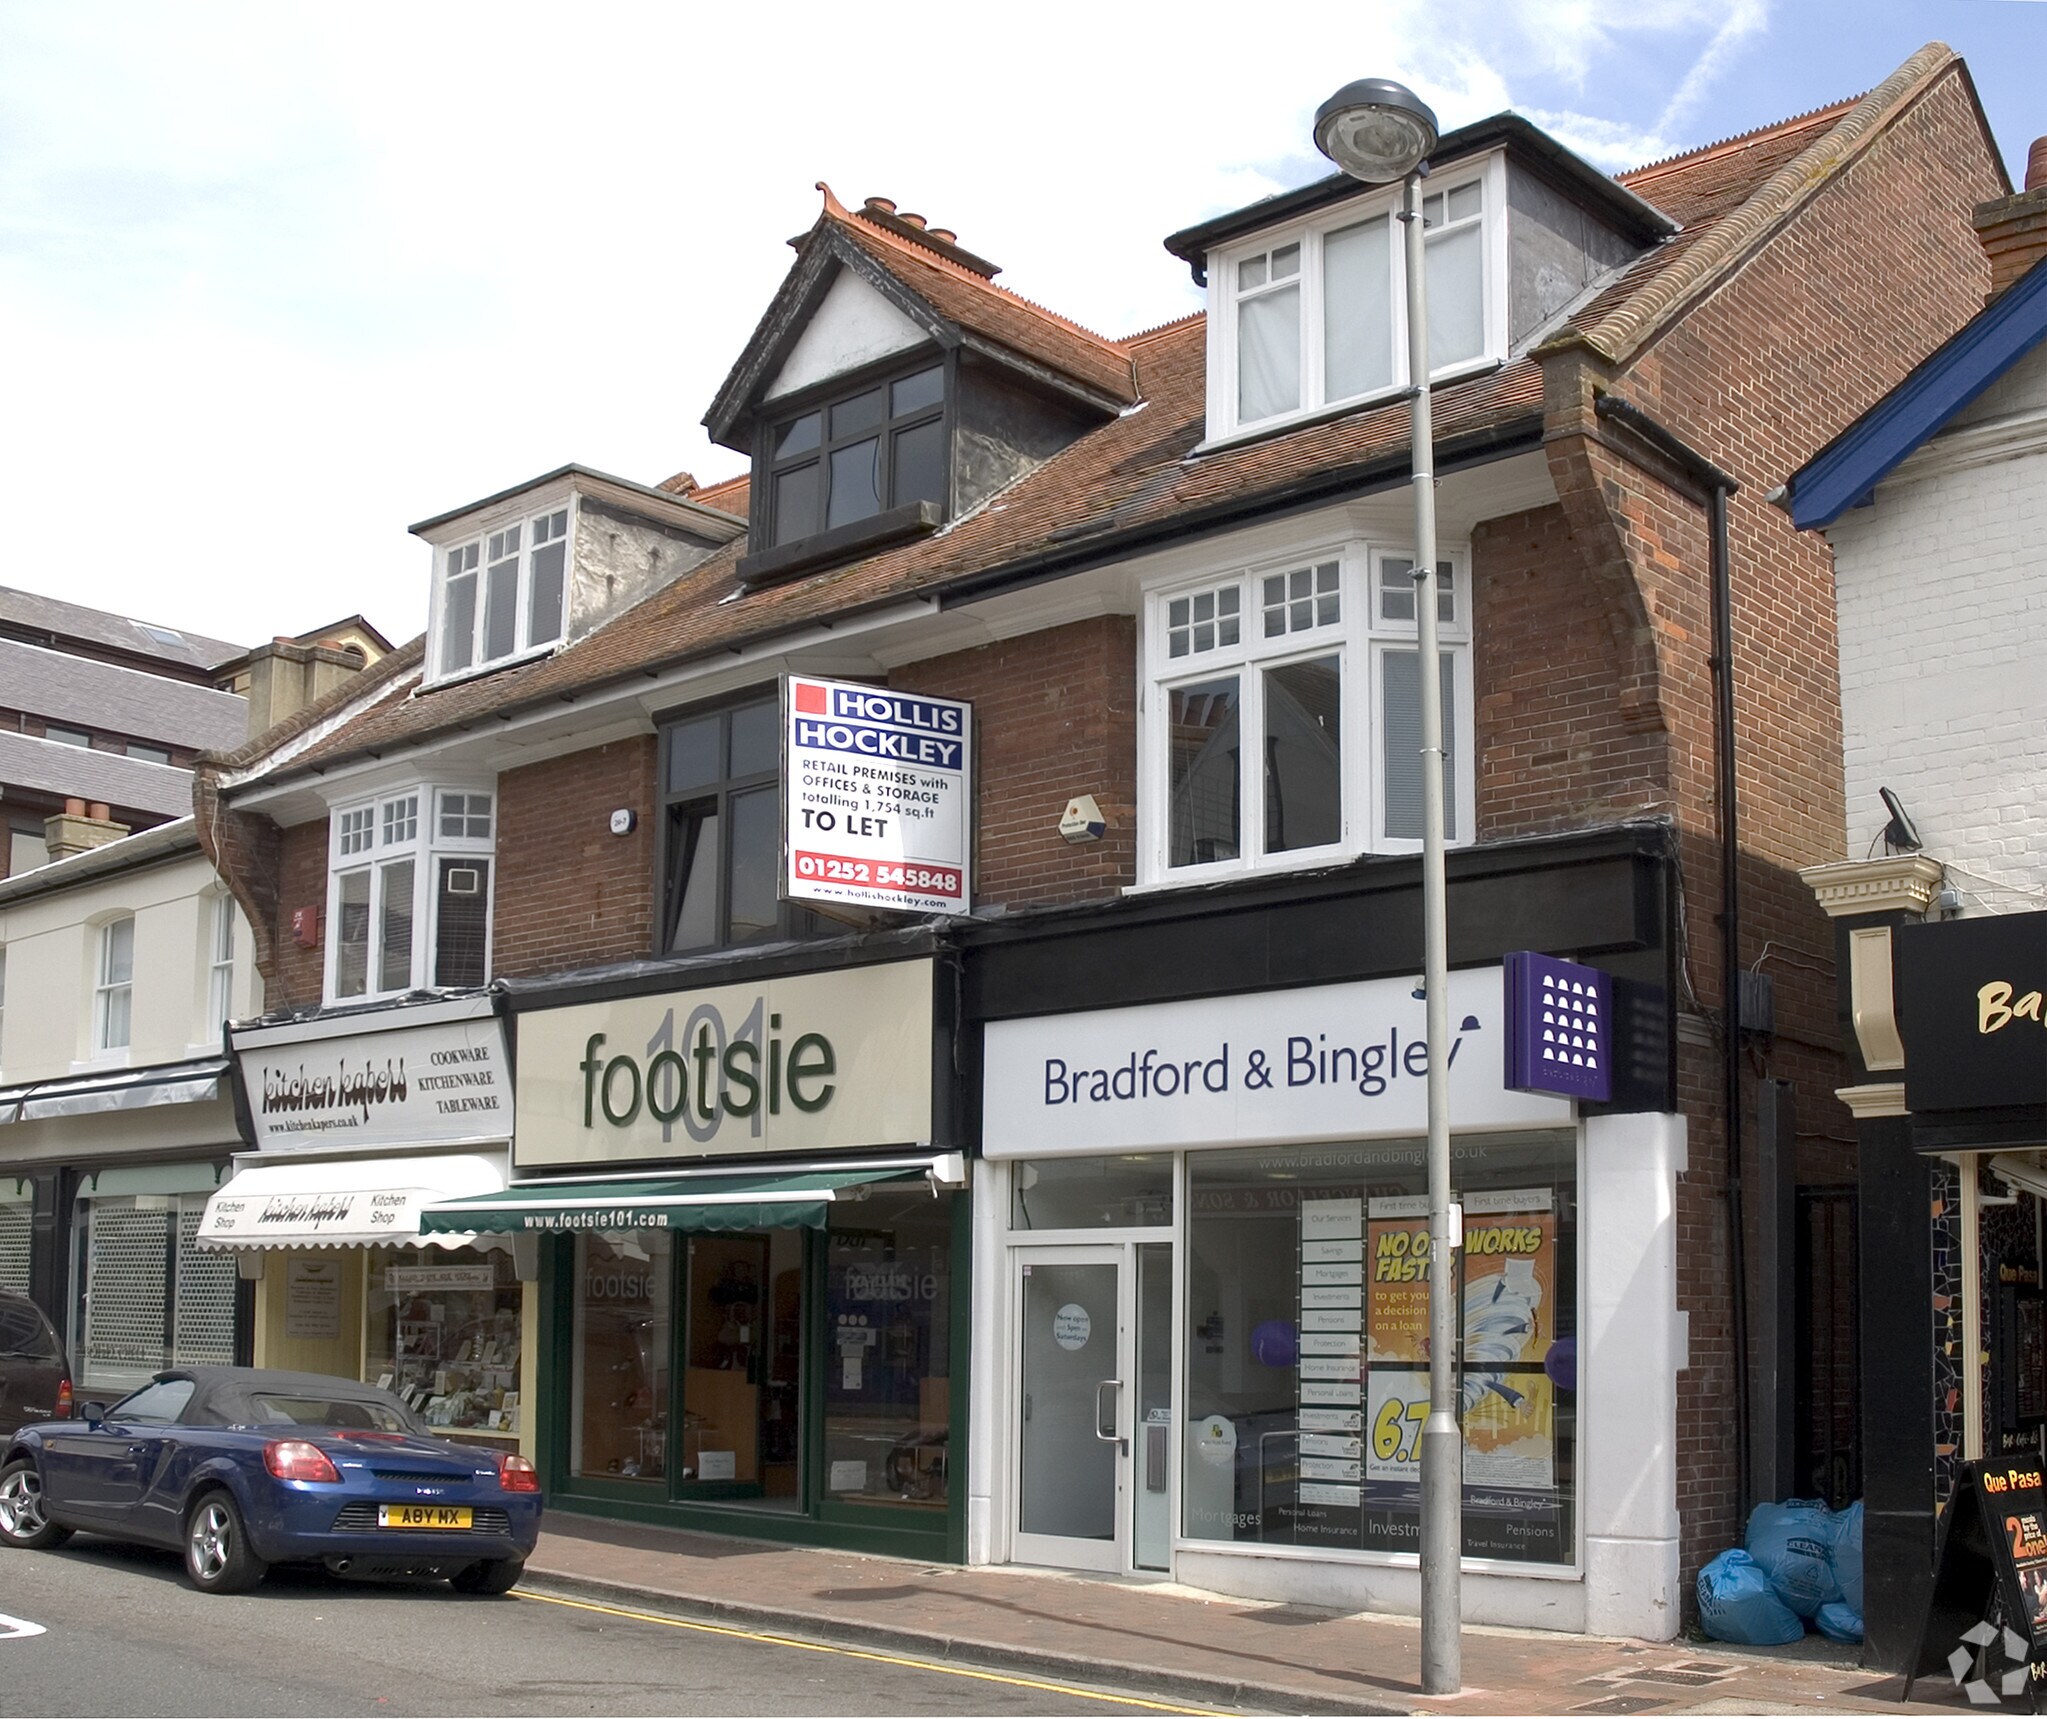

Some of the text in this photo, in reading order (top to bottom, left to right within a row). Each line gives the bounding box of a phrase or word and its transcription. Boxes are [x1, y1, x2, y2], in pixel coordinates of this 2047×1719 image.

[839, 692, 958, 732] HOLLIS
[799, 722, 957, 765] HOCKLEY
[802, 759, 949, 791] RETAIL PREMISES with
[802, 775, 940, 805] OFFICES & STORAGE
[802, 792, 935, 820] totalling 1,754 sq.ft
[801, 808, 888, 838] TO LET
[798, 856, 958, 892] 01252 545848
[813, 887, 947, 908] www.hollishockley.com
[1977, 980, 2047, 1034] Ba
[430, 1047, 490, 1066] COOKWARE
[579, 1012, 836, 1128] footsie
[646, 996, 763, 1144] 101
[1044, 1042, 1229, 1106] Bradford
[1244, 1049, 1274, 1091] &
[417, 1071, 495, 1092] KITCHENWARE
[435, 1096, 500, 1114] TABLEWARE
[268, 1115, 359, 1133] www.kitchenkapers.co.uk
[1259, 1145, 1487, 1169] www.bradfordandbinglco.uk
[215, 1200, 245, 1213] Kitchen
[370, 1194, 407, 1207] Kitchen
[214, 1216, 236, 1229] Shop
[370, 1211, 396, 1224] Shop
[523, 1209, 668, 1229] www.footsie101.com
[1376, 1230, 1411, 1258] NO
[1465, 1225, 1543, 1256] WORKS
[1375, 1255, 1456, 1284] FAST
[1999, 1263, 2038, 1284] Que Pasa
[584, 1270, 657, 1299] footsie
[844, 1266, 939, 1301] footsie
[1375, 1291, 1430, 1304] to get you
[1375, 1305, 1427, 1316] a decision
[1375, 1320, 1423, 1331] on a loan
[1984, 1469, 2043, 1494] Que Pasa
[1278, 1507, 1327, 1518] Personal Loans
[1470, 1494, 1505, 1507] Bradford
[1513, 1498, 1544, 1511] Bingley
[402, 1508, 460, 1525] A8Y MX
[1191, 1507, 1262, 1528] Mortgages
[1294, 1523, 1358, 1536] Home Insurance
[1369, 1519, 1421, 1537] Investm
[1506, 1524, 1555, 1538] Pensions
[2006, 1516, 2028, 1559] 2
[1466, 1537, 1526, 1551] Travel Insurance
